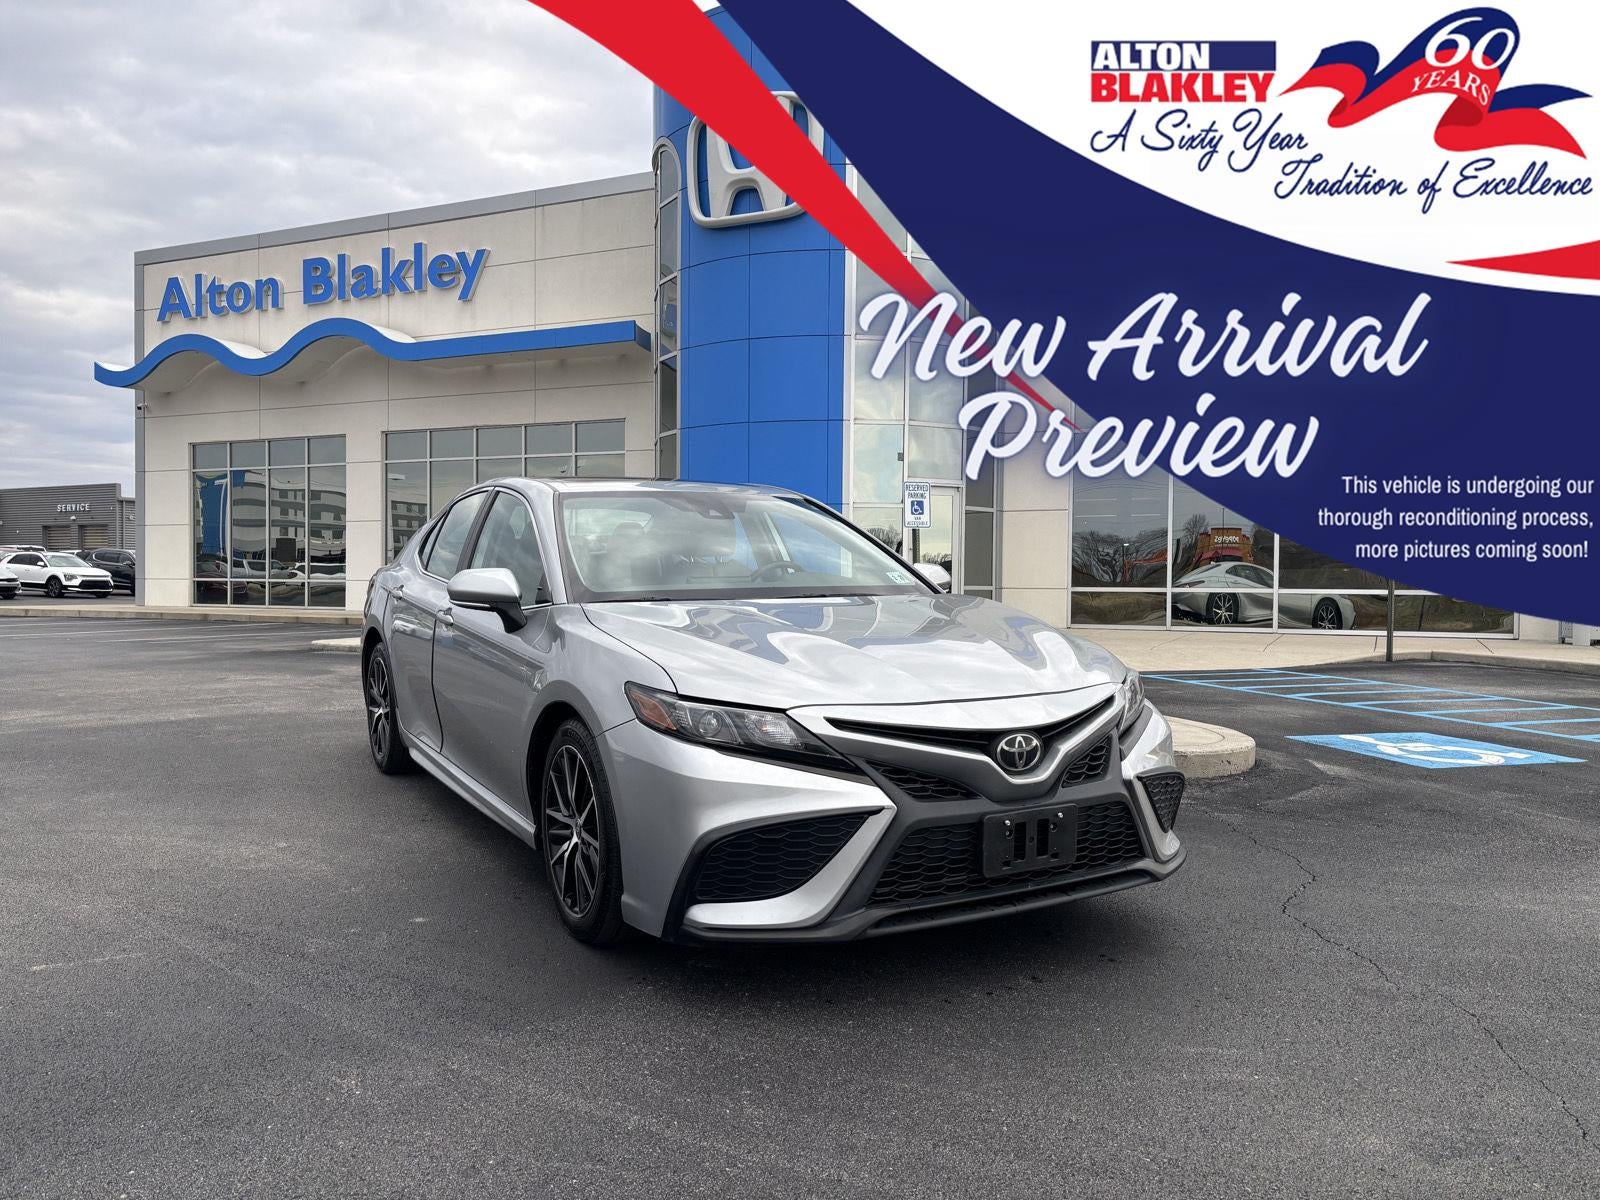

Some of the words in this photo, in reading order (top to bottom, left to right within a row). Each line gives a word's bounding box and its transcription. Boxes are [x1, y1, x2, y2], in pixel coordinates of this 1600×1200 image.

[157, 273, 284, 322] Alton
[302, 242, 491, 304] Blakley
[908, 492, 927, 500] PARKING
[57, 503, 91, 512] SERVICE
